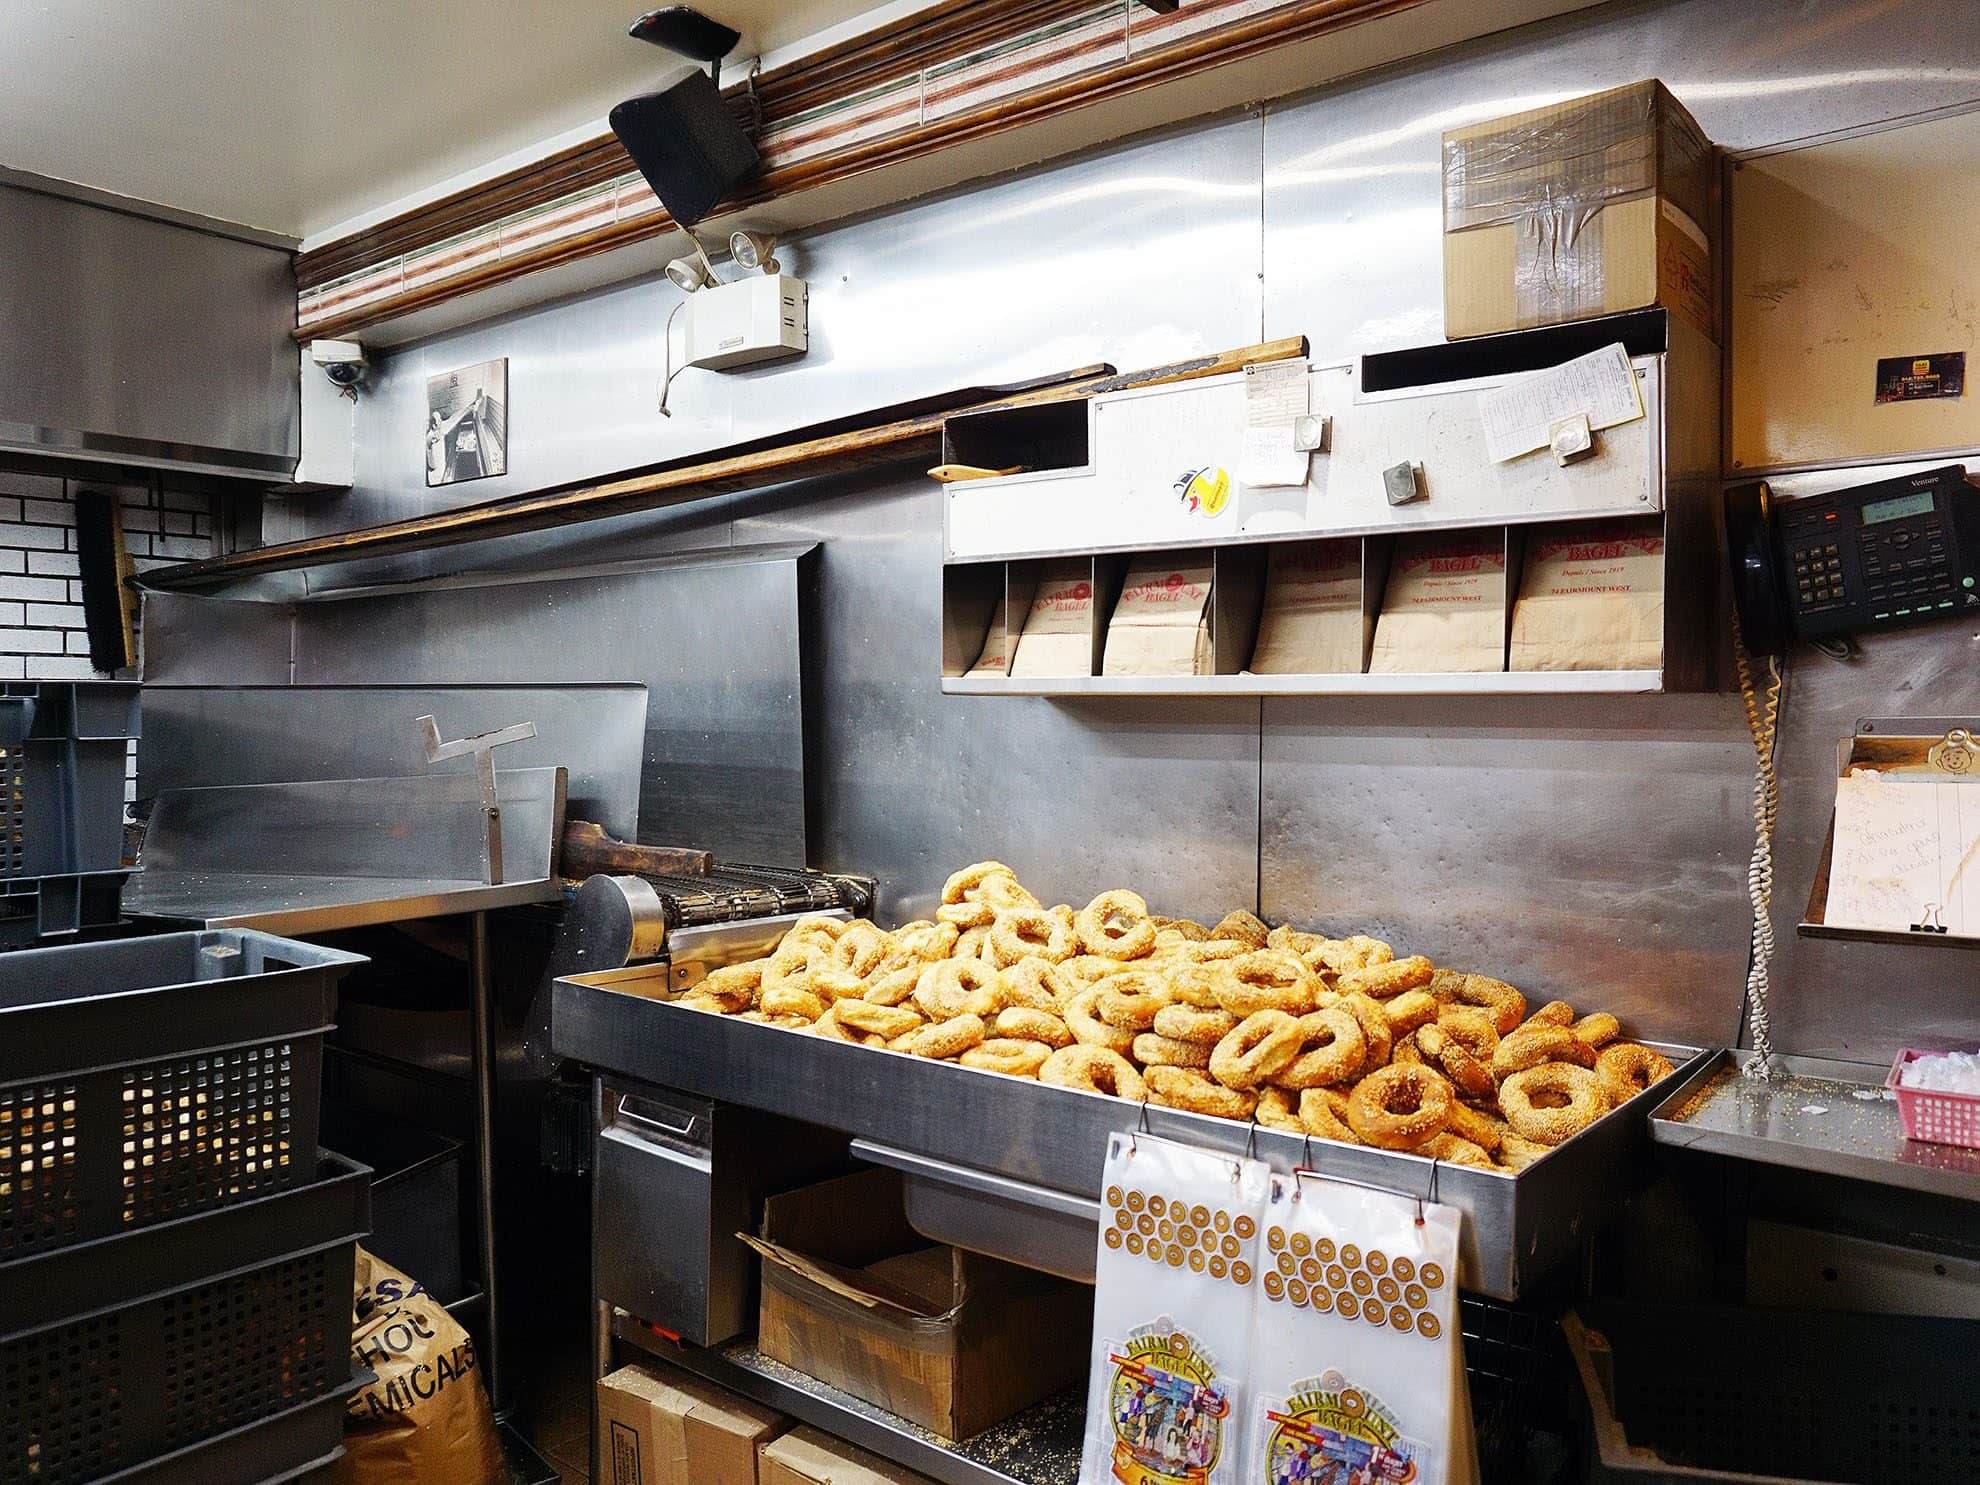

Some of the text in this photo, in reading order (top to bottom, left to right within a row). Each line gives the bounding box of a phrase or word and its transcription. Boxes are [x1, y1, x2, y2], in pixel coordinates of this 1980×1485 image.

[1567, 542, 1626, 562] BAGEL
[1562, 569, 1584, 577] Depuis
[1590, 568, 1607, 576] Since
[1608, 566, 1625, 574] 1919
[1559, 585, 1606, 595] FAIRMOUNT
[1608, 584, 1632, 593] WEST
[1126, 1333, 1216, 1380] FAIRMOUNT
[1287, 1388, 1400, 1441] FAIRMOUNT
